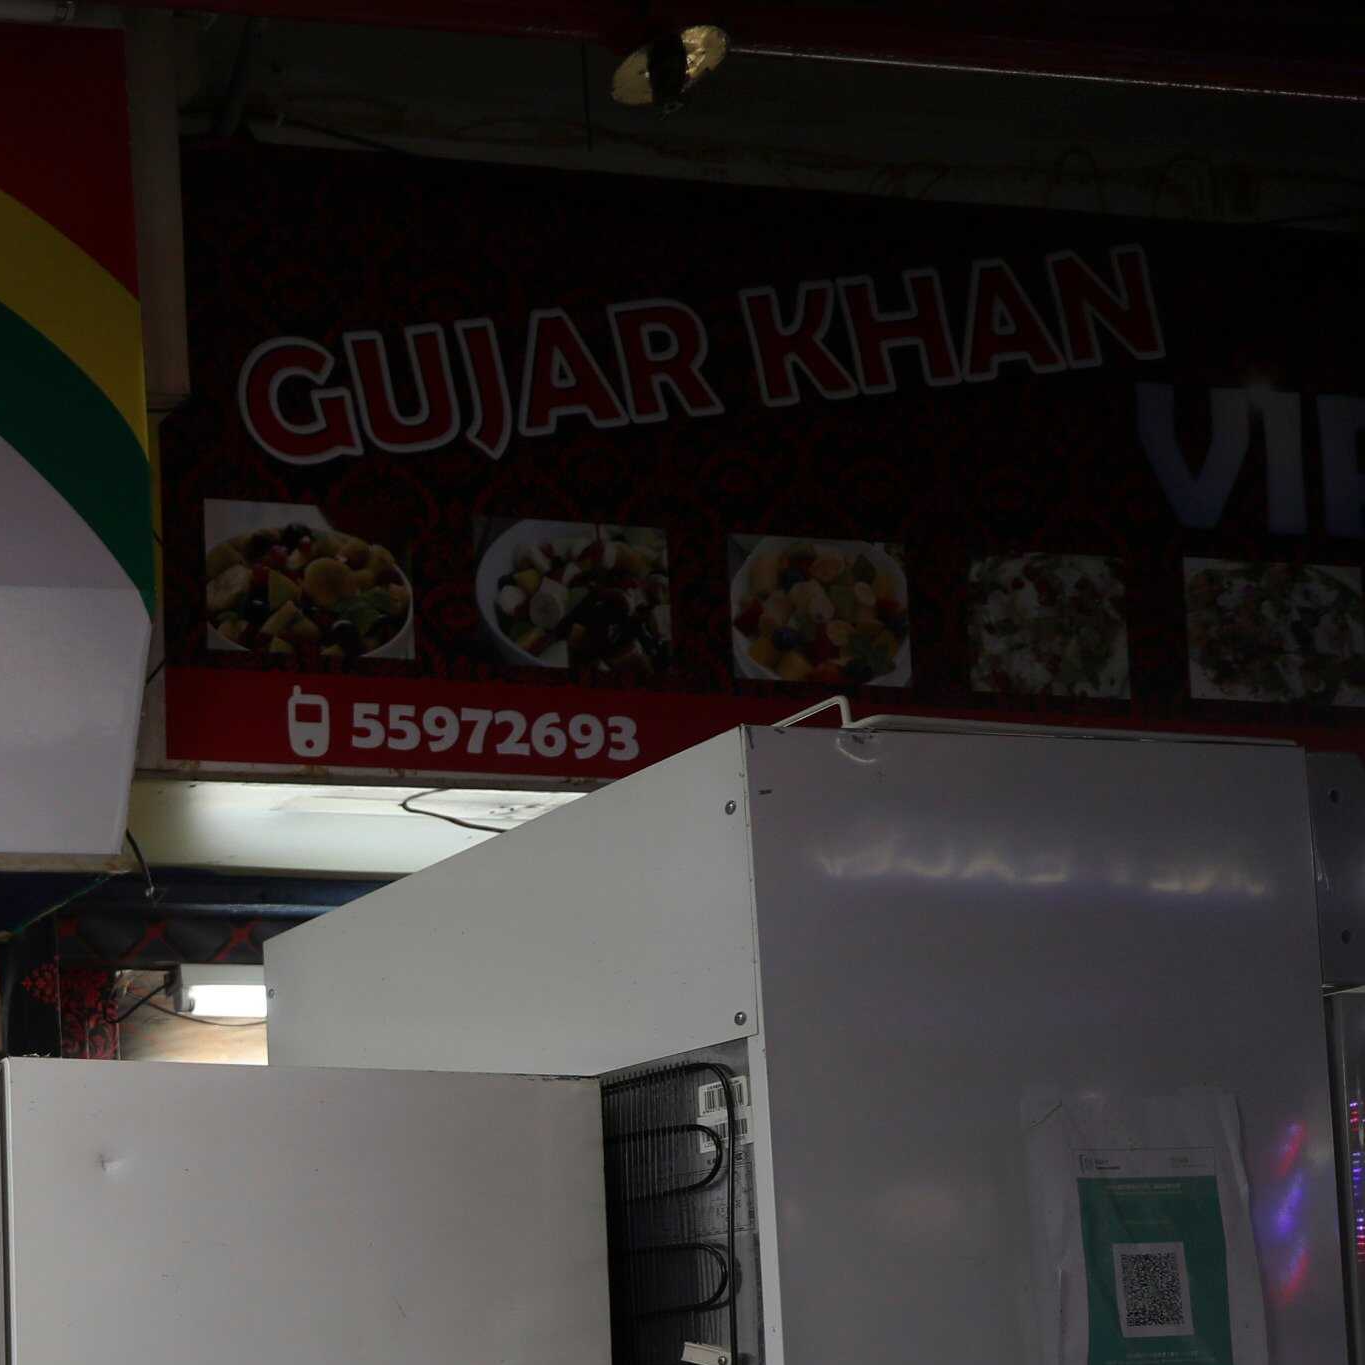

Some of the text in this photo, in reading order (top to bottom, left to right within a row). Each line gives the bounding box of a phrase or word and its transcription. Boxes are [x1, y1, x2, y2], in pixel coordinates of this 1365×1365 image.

[237, 243, 1167, 466] GUJAR KHAN
[351, 700, 640, 763] 55972693
